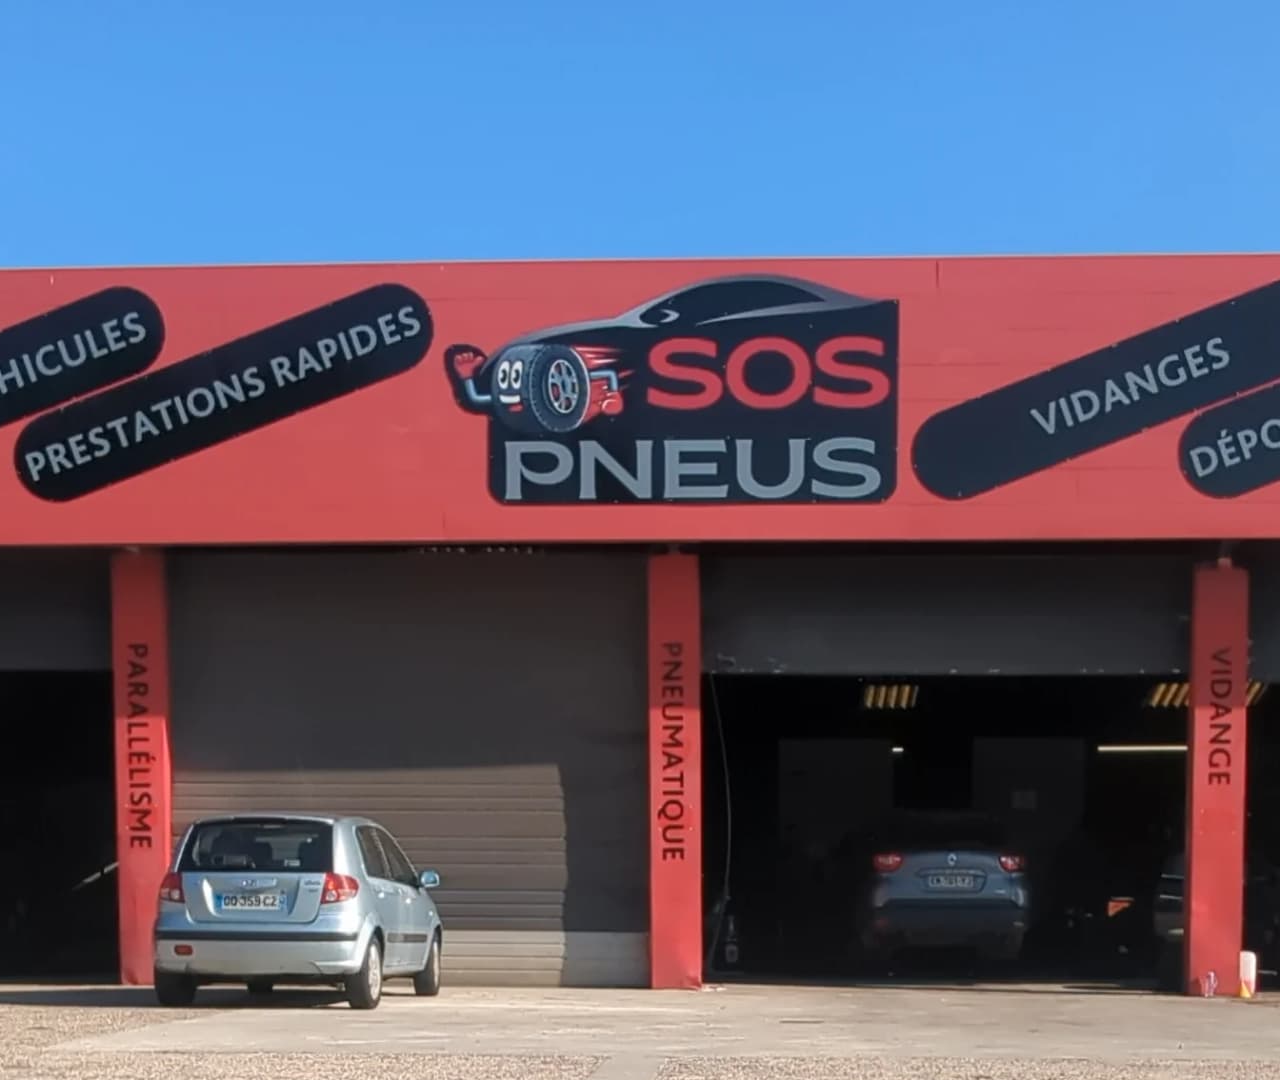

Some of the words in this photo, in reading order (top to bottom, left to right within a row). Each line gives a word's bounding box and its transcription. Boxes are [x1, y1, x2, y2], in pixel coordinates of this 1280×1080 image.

[25, 367, 266, 481] PRESTATIONS
[270, 306, 421, 388] RAPIDES
[647, 336, 890, 410] SOS
[1030, 337, 1230, 435] VIDANGES
[505, 437, 881, 499] PNEUS
[127, 643, 156, 848] PARALLÉLISME
[657, 643, 684, 860] PNEUMATIQUE
[1208, 648, 1232, 785] VIDANGE
